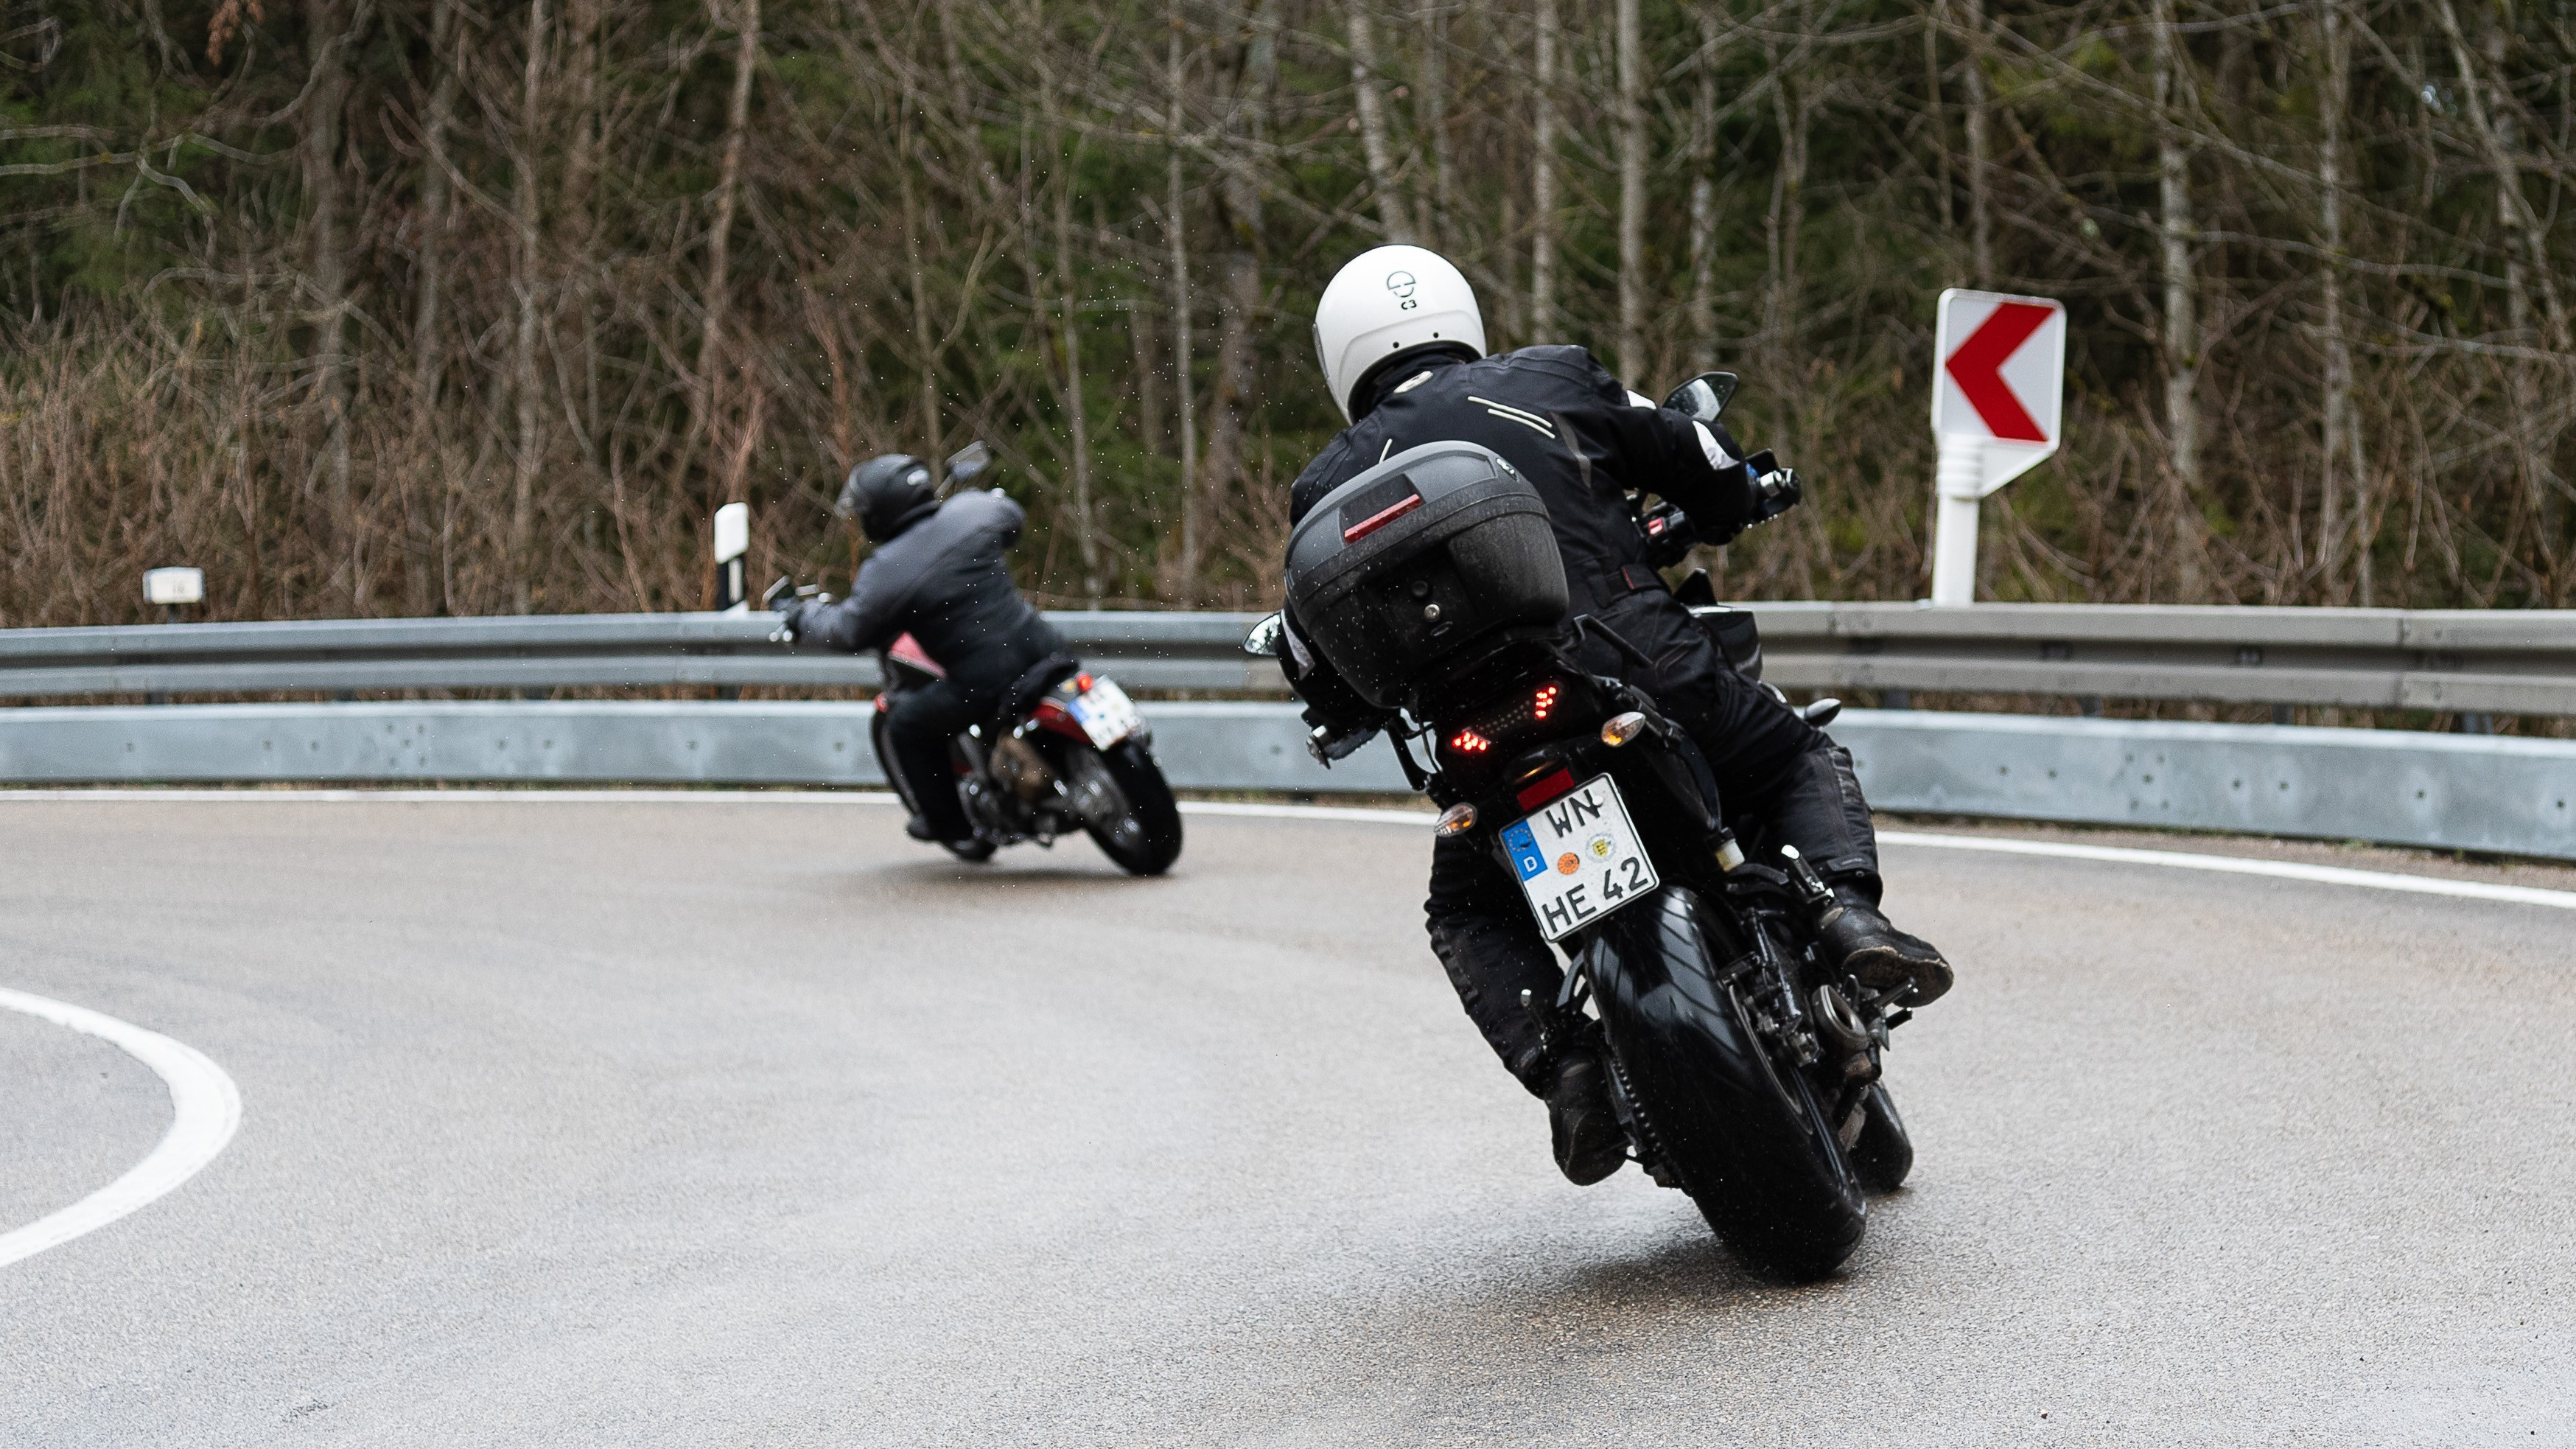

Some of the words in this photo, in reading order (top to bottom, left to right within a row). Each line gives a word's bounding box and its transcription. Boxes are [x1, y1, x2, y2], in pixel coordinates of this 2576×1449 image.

[1401, 299, 1417, 310] C3
[1545, 789, 1601, 838] WN
[1523, 856, 1538, 872] D
[1542, 884, 1597, 933] HE
[1603, 856, 1648, 900] 42
